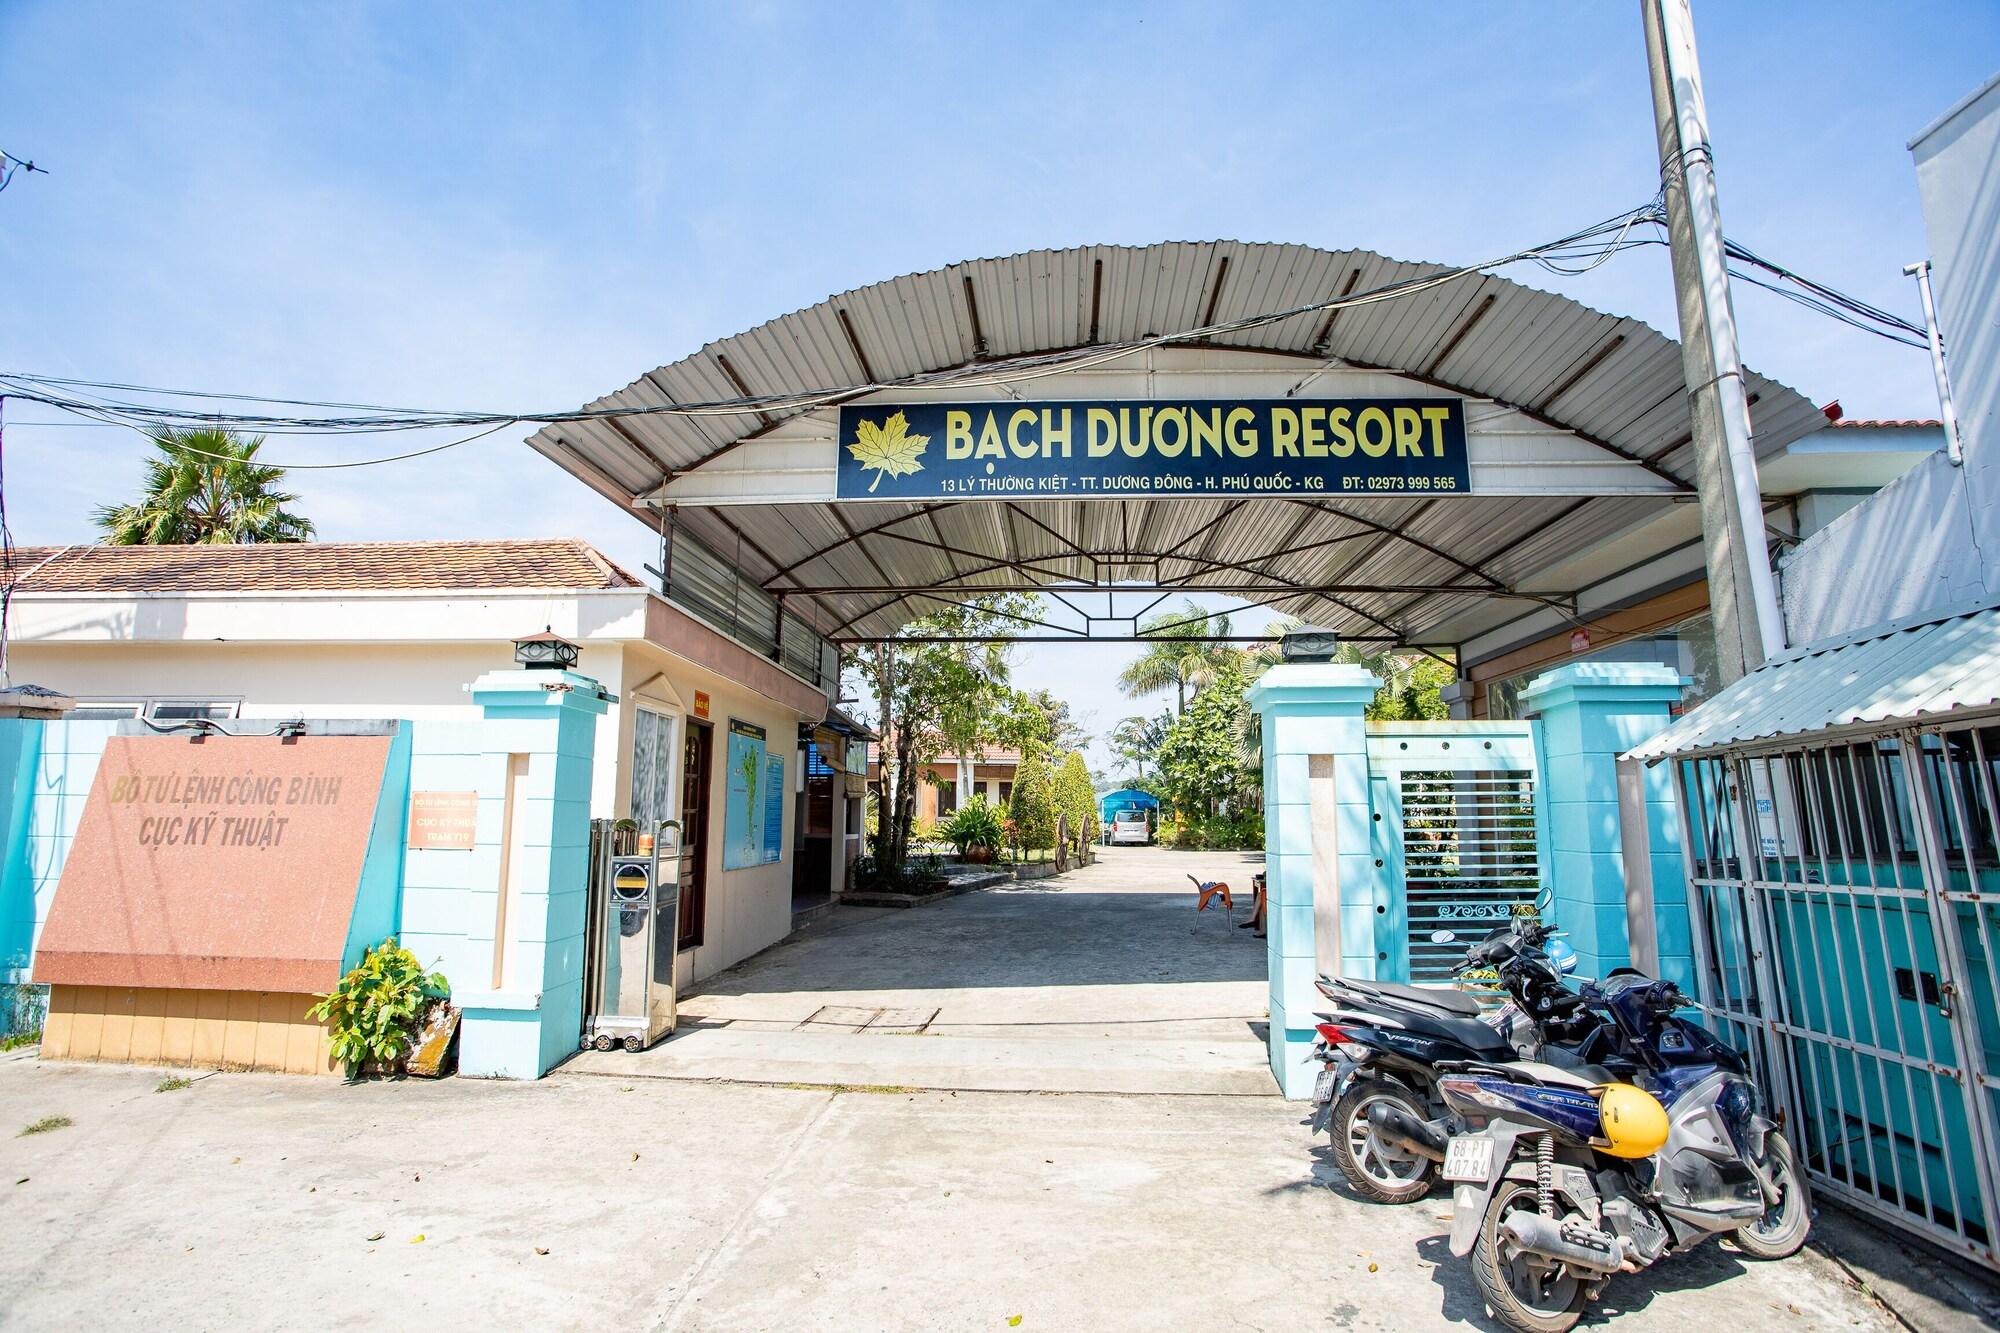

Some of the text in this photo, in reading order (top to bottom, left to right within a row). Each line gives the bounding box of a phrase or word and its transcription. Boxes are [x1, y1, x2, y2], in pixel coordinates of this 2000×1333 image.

[946, 406, 1450, 475] BẠCH DƯƠNG RESORT
[941, 479, 955, 492] 13
[959, 475, 975, 491] LÝ
[979, 475, 1034, 491] THƯỜNG
[1038, 474, 1069, 493] KIỆT
[1080, 477, 1099, 490] TT.
[1102, 475, 1150, 490] DƯƠNG
[1153, 473, 1193, 490] ĐÔNG
[1205, 476, 1218, 489] H.
[1222, 473, 1250, 489] PHÚ
[1254, 471, 1293, 490] QUỐC
[1304, 476, 1324, 490] KG
[1342, 476, 1364, 490] ĐT:
[1367, 476, 1405, 490] 02973
[1407, 476, 1431, 490] 999
[1433, 476, 1456, 490] 565
[111, 769, 142, 809] BỘ
[143, 770, 176, 804] TƯ
[170, 768, 225, 809] LỆNH
[225, 769, 282, 806] CÔNG
[138, 810, 289, 851] CỤC KỸ THUẬT
